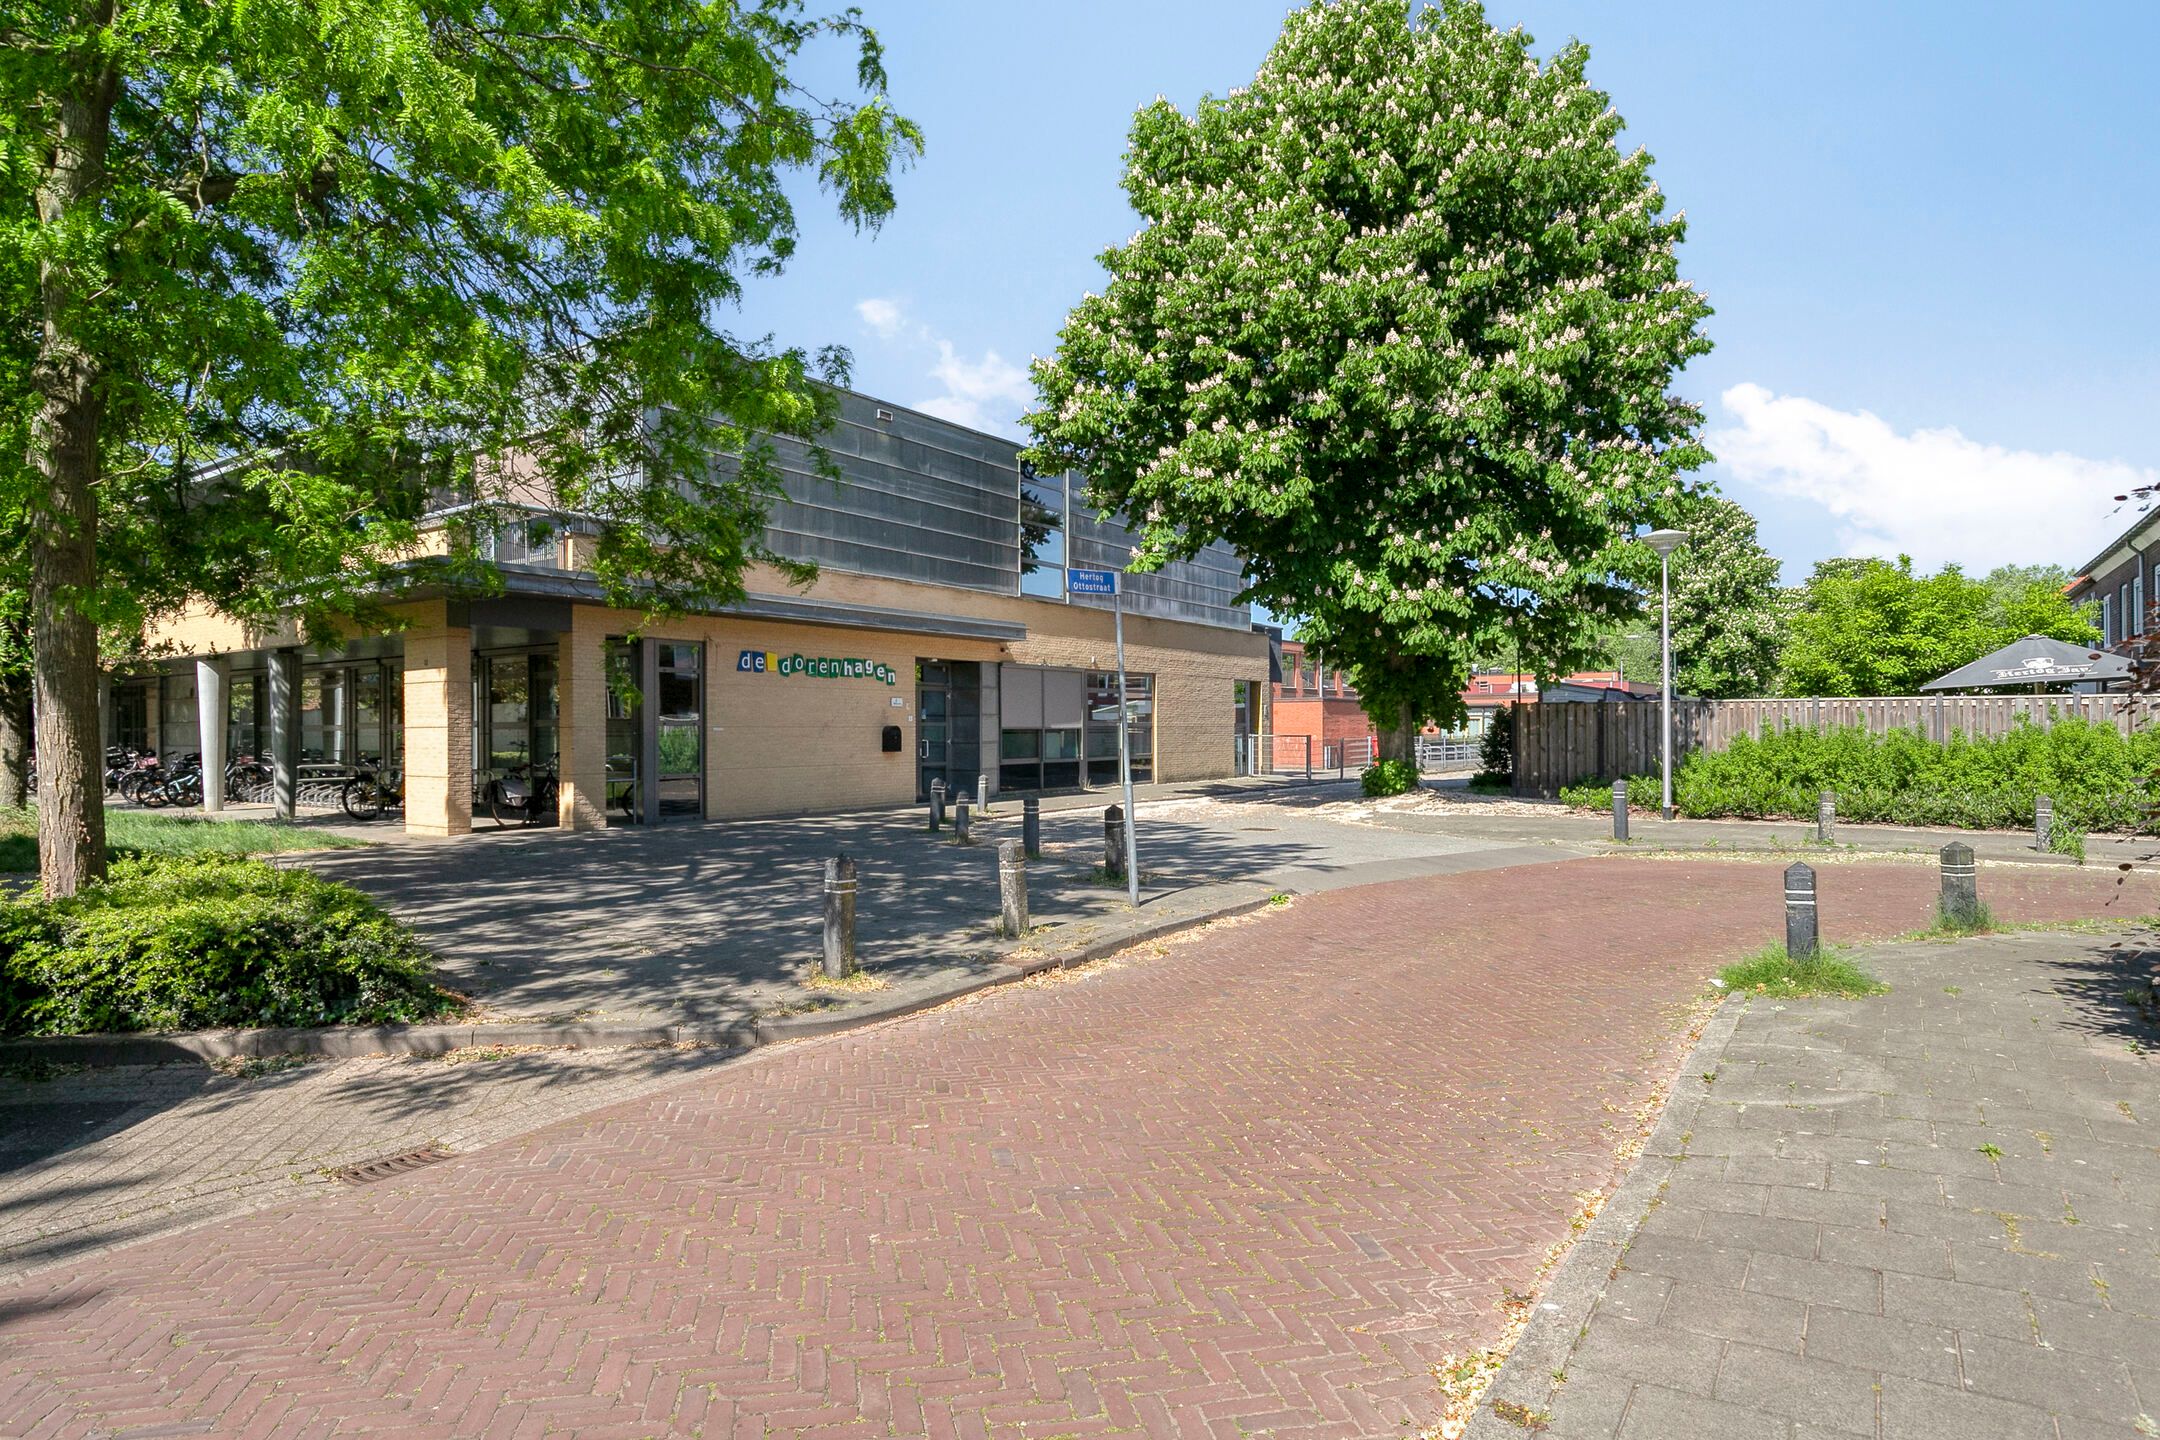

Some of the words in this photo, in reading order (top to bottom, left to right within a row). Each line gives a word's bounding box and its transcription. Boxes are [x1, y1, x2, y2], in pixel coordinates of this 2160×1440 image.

[1079, 571, 1104, 583] Hertog
[1073, 582, 1111, 592] Ottostraat
[741, 655, 765, 669] de
[781, 656, 896, 683] dorenhagen
